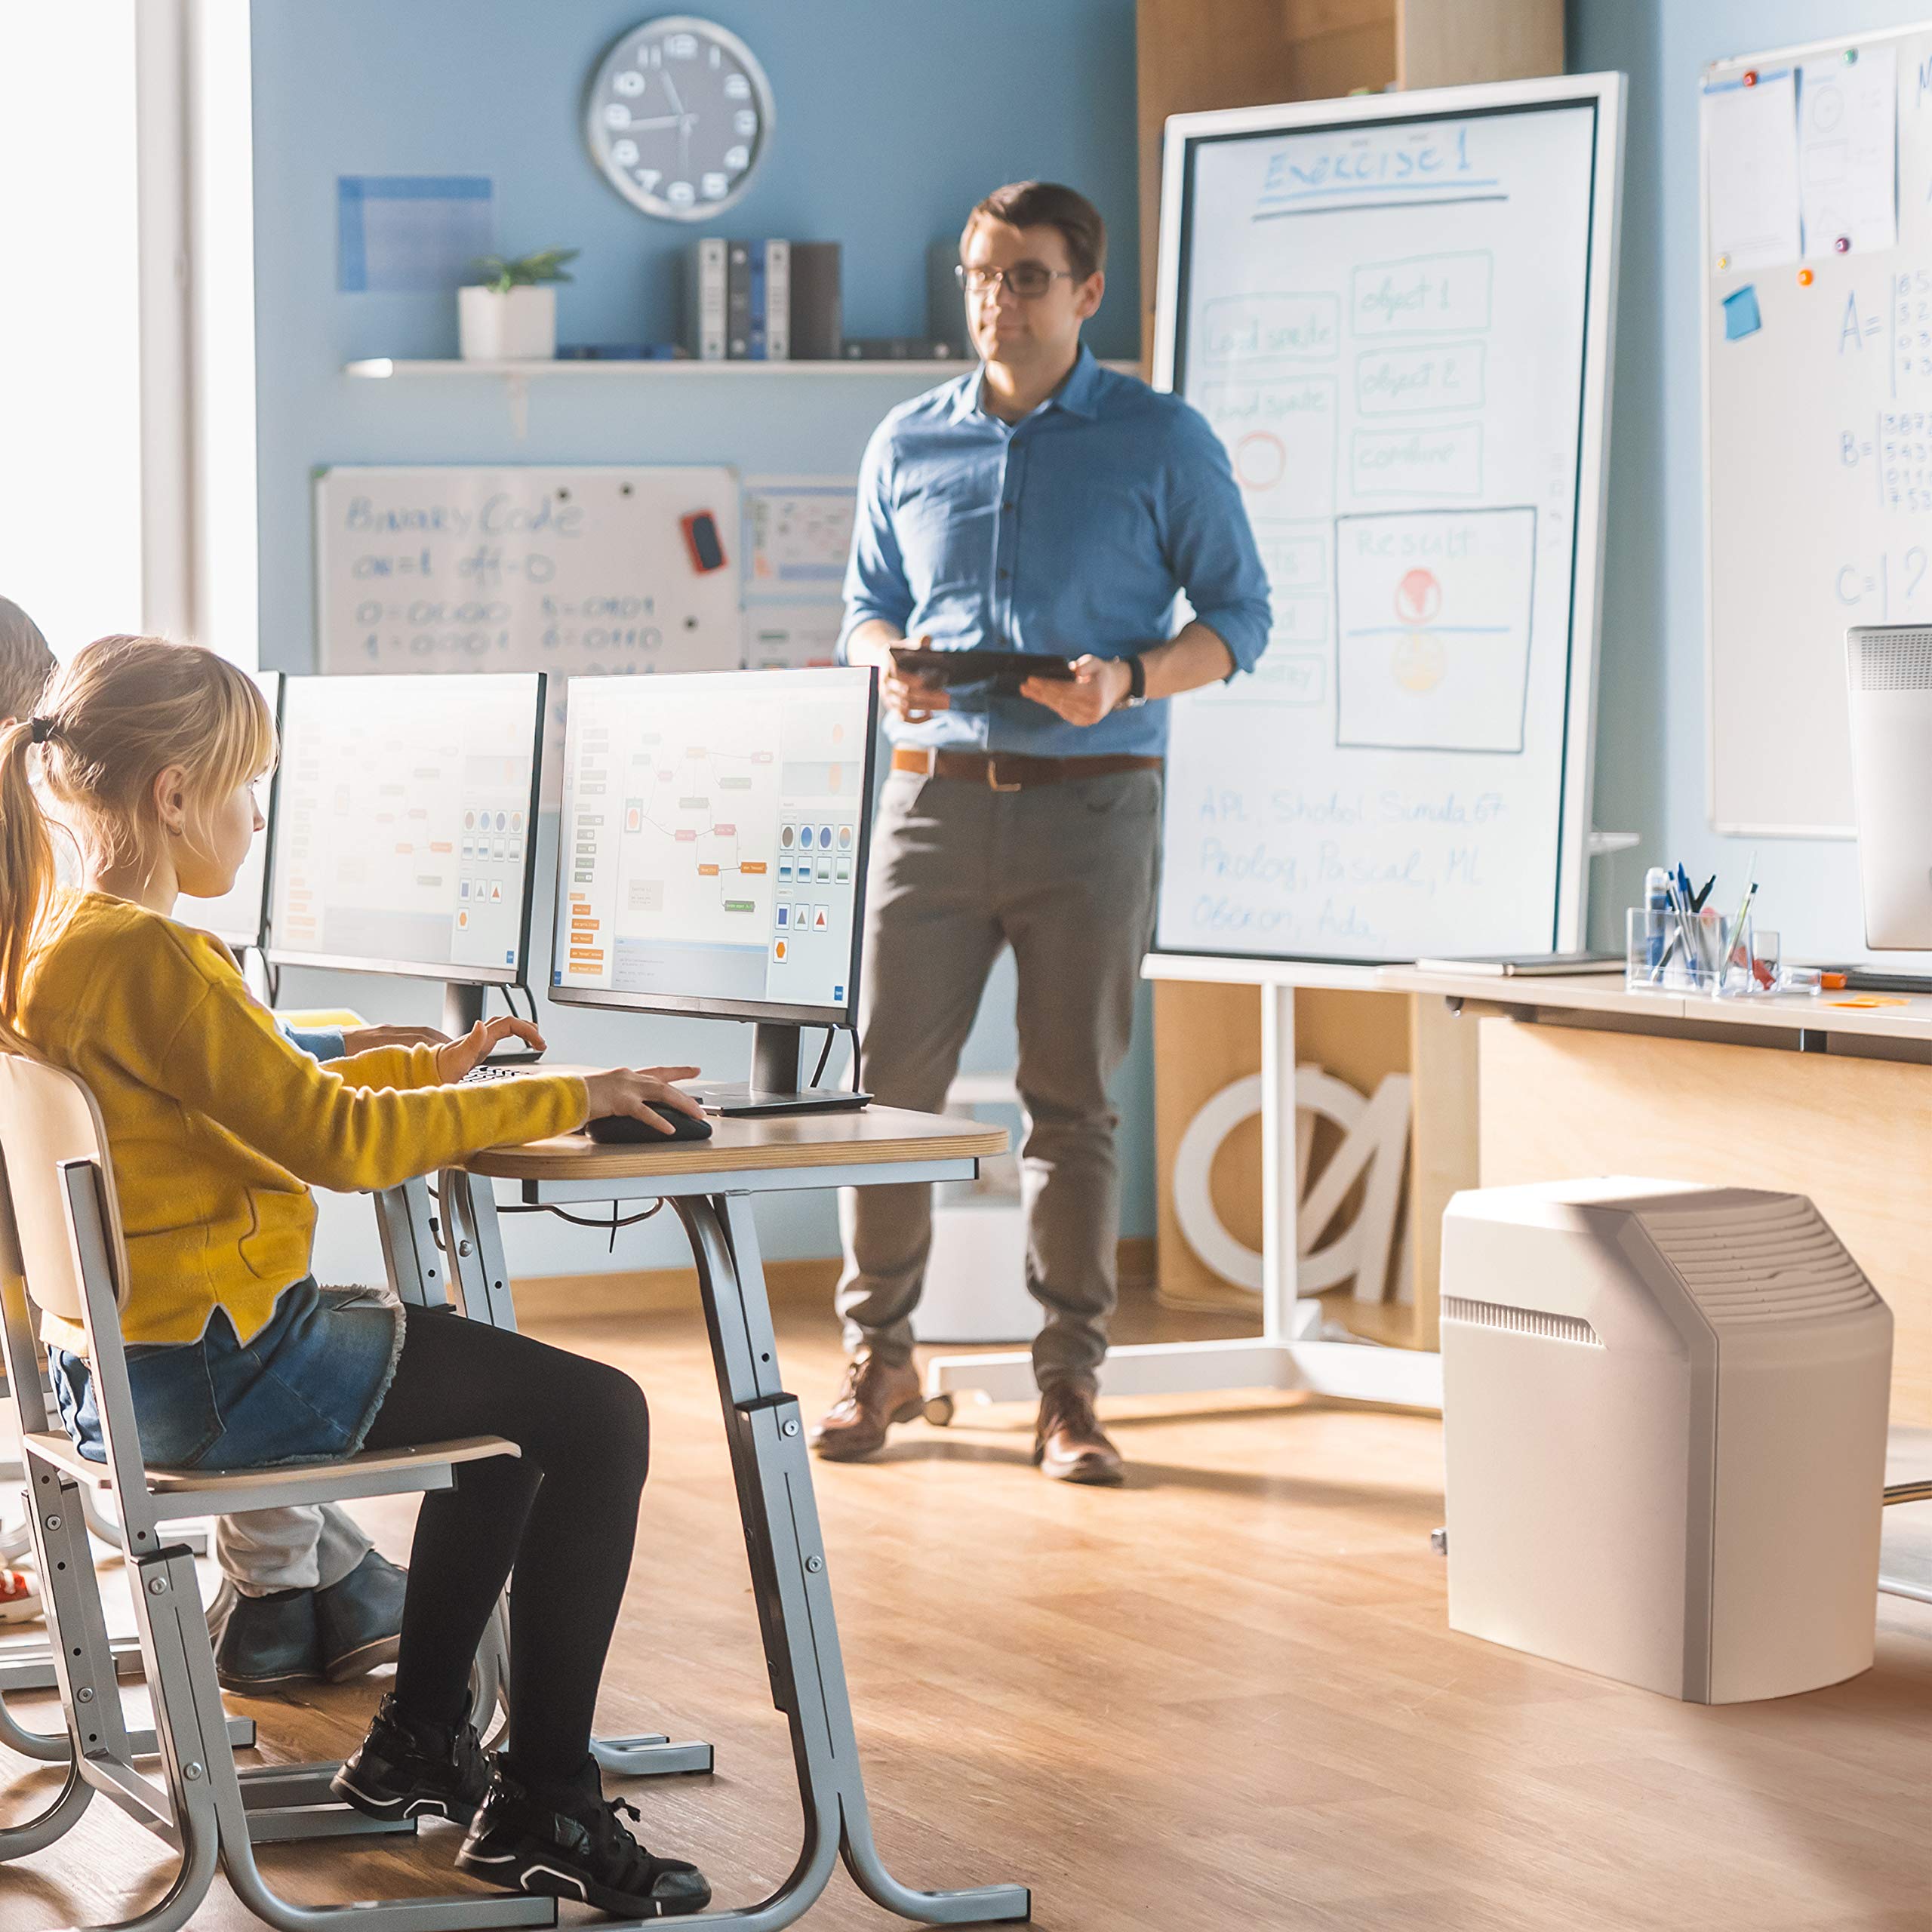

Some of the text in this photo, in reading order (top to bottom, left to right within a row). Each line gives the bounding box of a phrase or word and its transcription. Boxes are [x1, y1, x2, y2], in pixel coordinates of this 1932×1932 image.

[637, 44, 661, 69] 11
[709, 44, 721, 69] 1
[612, 71, 645, 98] 10
[635, 169, 662, 194] 7
[700, 172, 728, 199] 5
